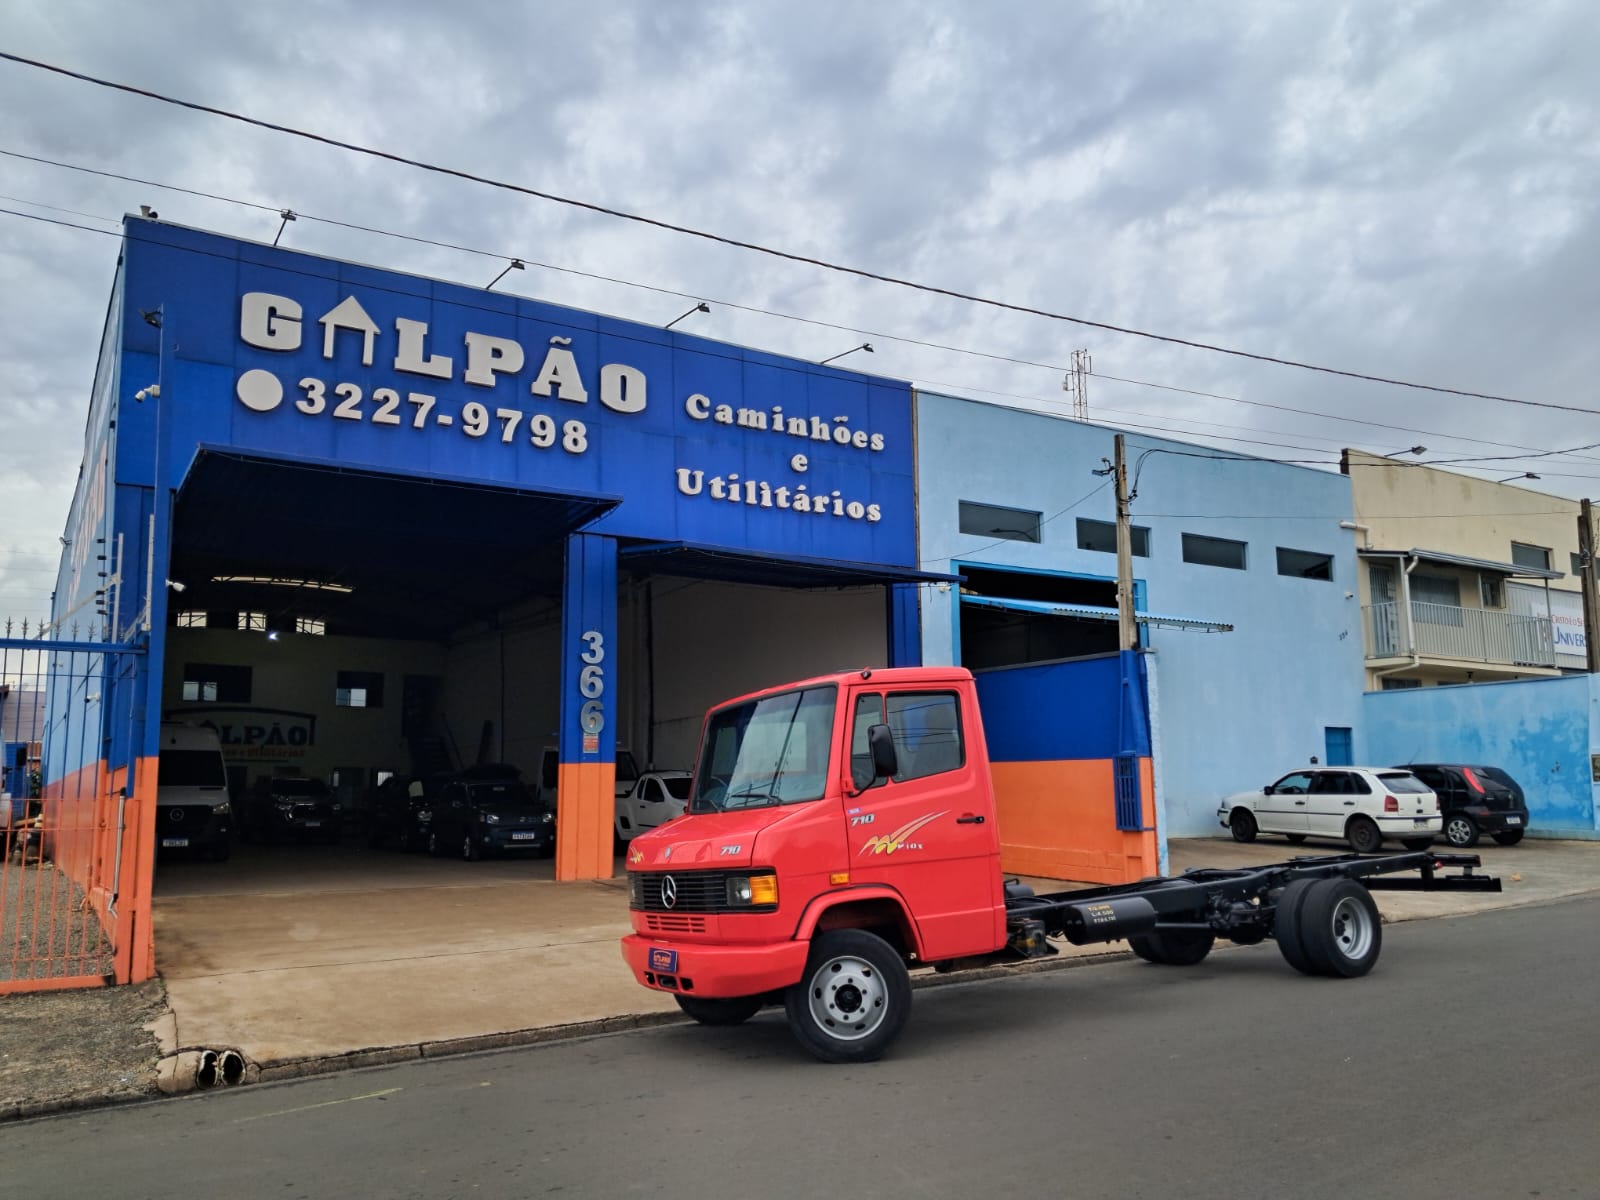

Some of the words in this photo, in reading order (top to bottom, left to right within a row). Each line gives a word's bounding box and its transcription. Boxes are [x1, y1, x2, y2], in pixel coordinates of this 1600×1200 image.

[295, 377, 589, 453] 3227-9798
[685, 393, 885, 452] Caminhões
[791, 453, 809, 473] e
[676, 467, 882, 522] Utilitários
[1553, 626, 1586, 647] UNIVER
[580, 630, 605, 735] 366
[851, 813, 875, 827] 710
[720, 845, 742, 857] 710
